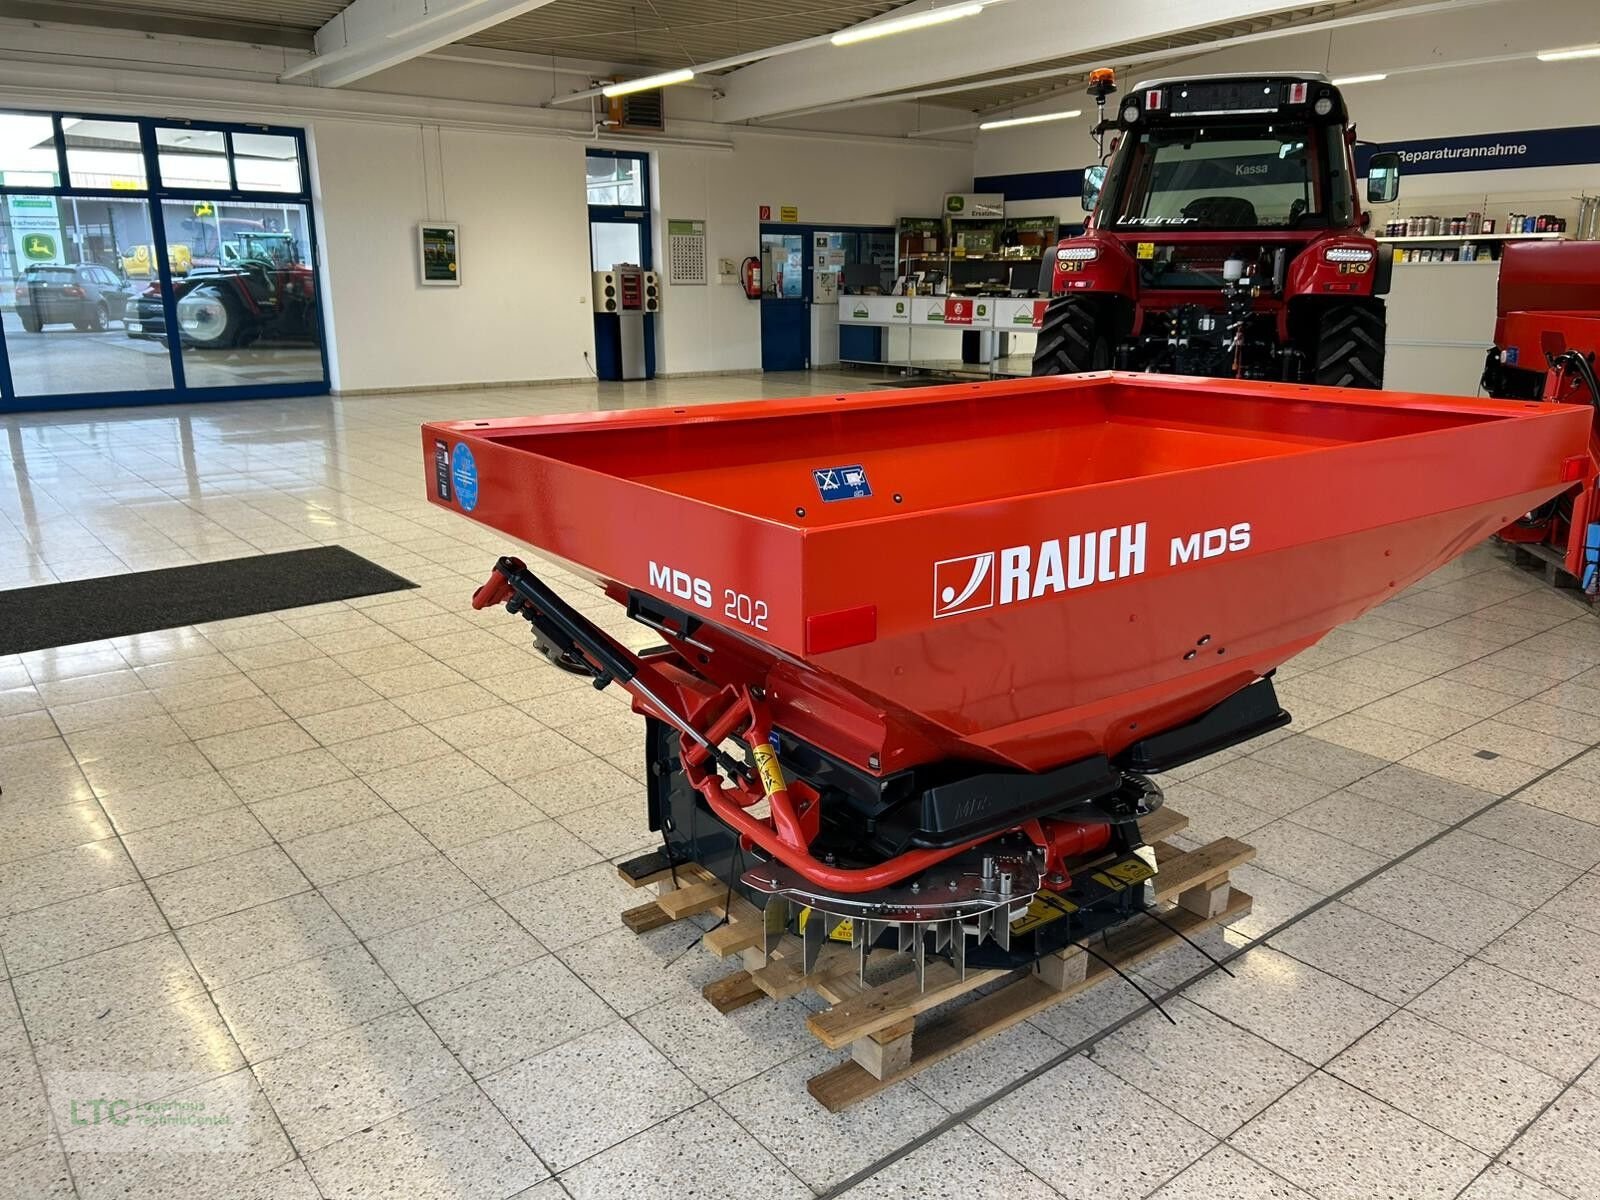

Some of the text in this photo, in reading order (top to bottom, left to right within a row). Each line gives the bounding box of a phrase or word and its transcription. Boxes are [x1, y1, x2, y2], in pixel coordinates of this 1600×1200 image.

[1398, 144, 1527, 163] Reparaturannahme
[1235, 163, 1269, 176] Kassa
[1116, 215, 1199, 225] Lindner
[999, 522, 1251, 605] RAUCH MDS
[648, 560, 769, 632] MDS 20.2
